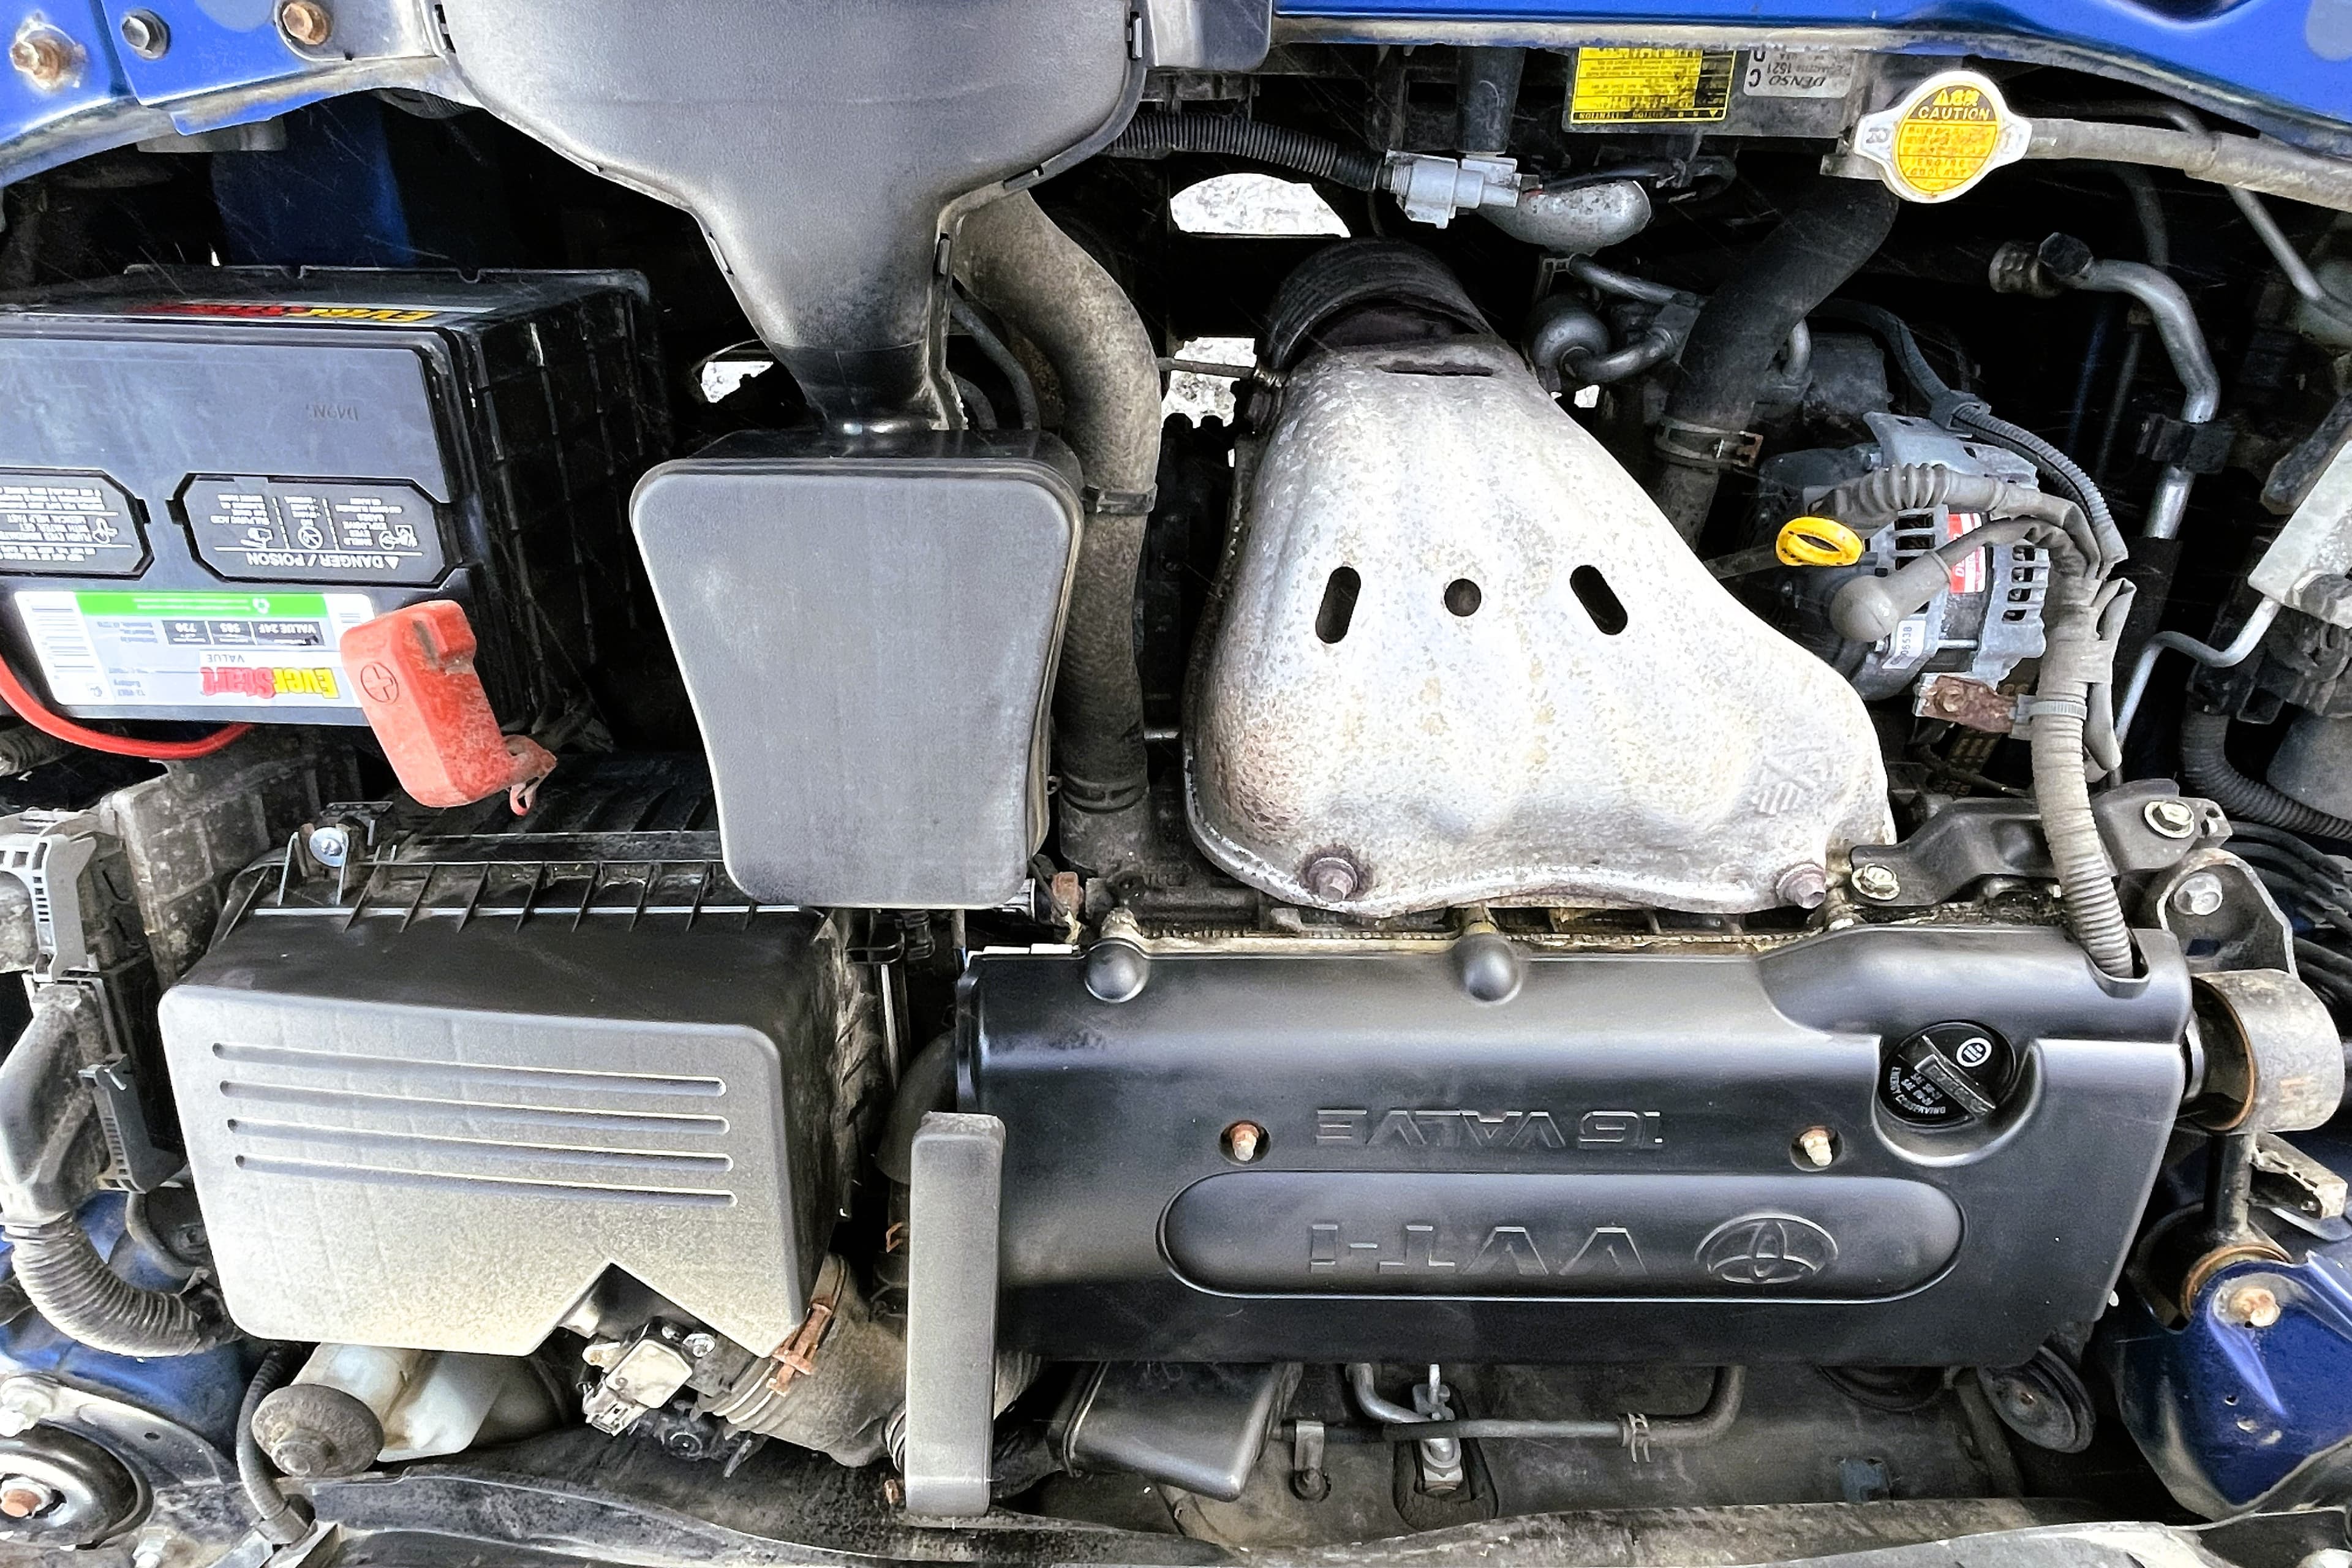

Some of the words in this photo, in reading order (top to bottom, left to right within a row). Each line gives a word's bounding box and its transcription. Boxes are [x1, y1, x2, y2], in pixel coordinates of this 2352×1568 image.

[1766, 62, 1792, 74] 1521
[1768, 75, 1826, 89] DENSO
[1918, 106, 1990, 121] CAUTION
[246, 552, 306, 567] POISON
[318, 554, 385, 569] DANGER
[281, 624, 317, 634] VALUE
[207, 654, 245, 663] VALUE
[200, 666, 341, 699] EverStart
[1314, 1109, 1566, 1148] VALVE
[1578, 1110, 1664, 1150] 16
